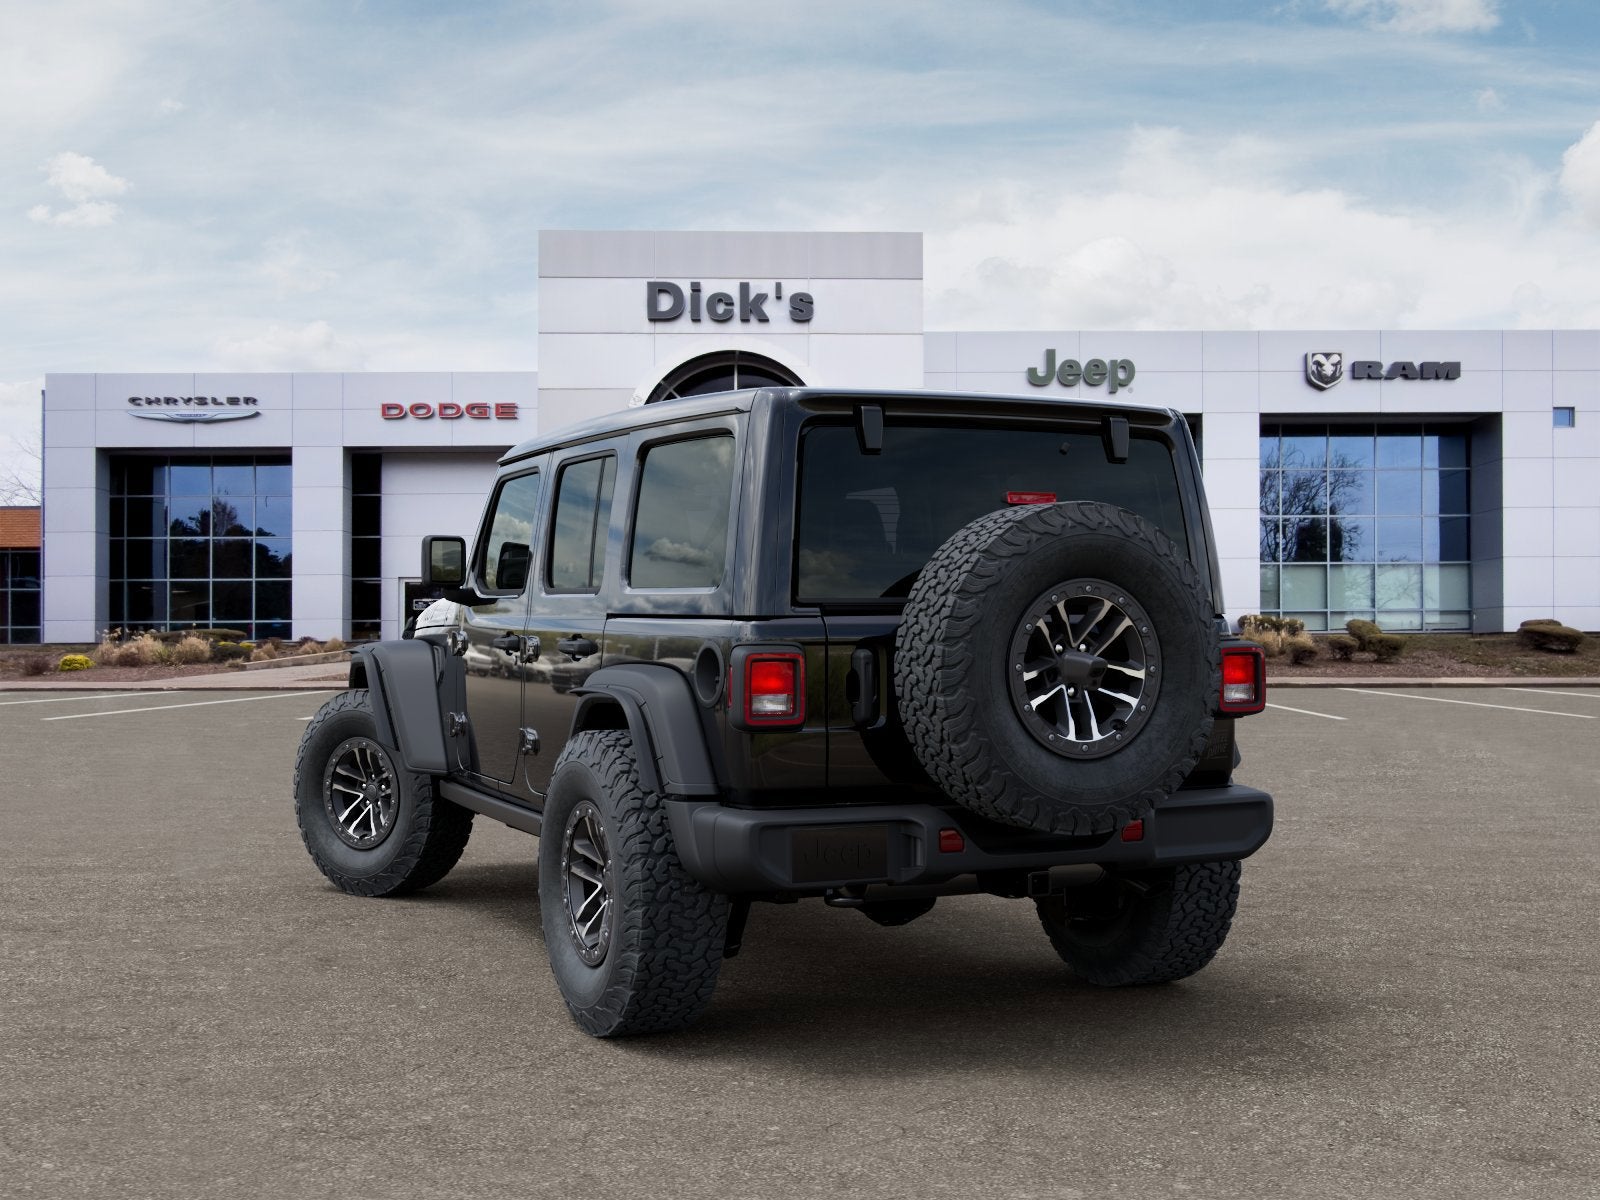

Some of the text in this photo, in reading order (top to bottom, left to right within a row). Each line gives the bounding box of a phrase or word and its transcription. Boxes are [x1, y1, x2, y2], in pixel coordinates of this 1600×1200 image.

[647, 281, 815, 323] Dick's
[1026, 348, 1136, 394] Jeep
[1352, 360, 1461, 380] RAM
[128, 396, 259, 406] CHRYSLER
[381, 402, 519, 420] DODGE
[803, 838, 872, 868] Jeep
